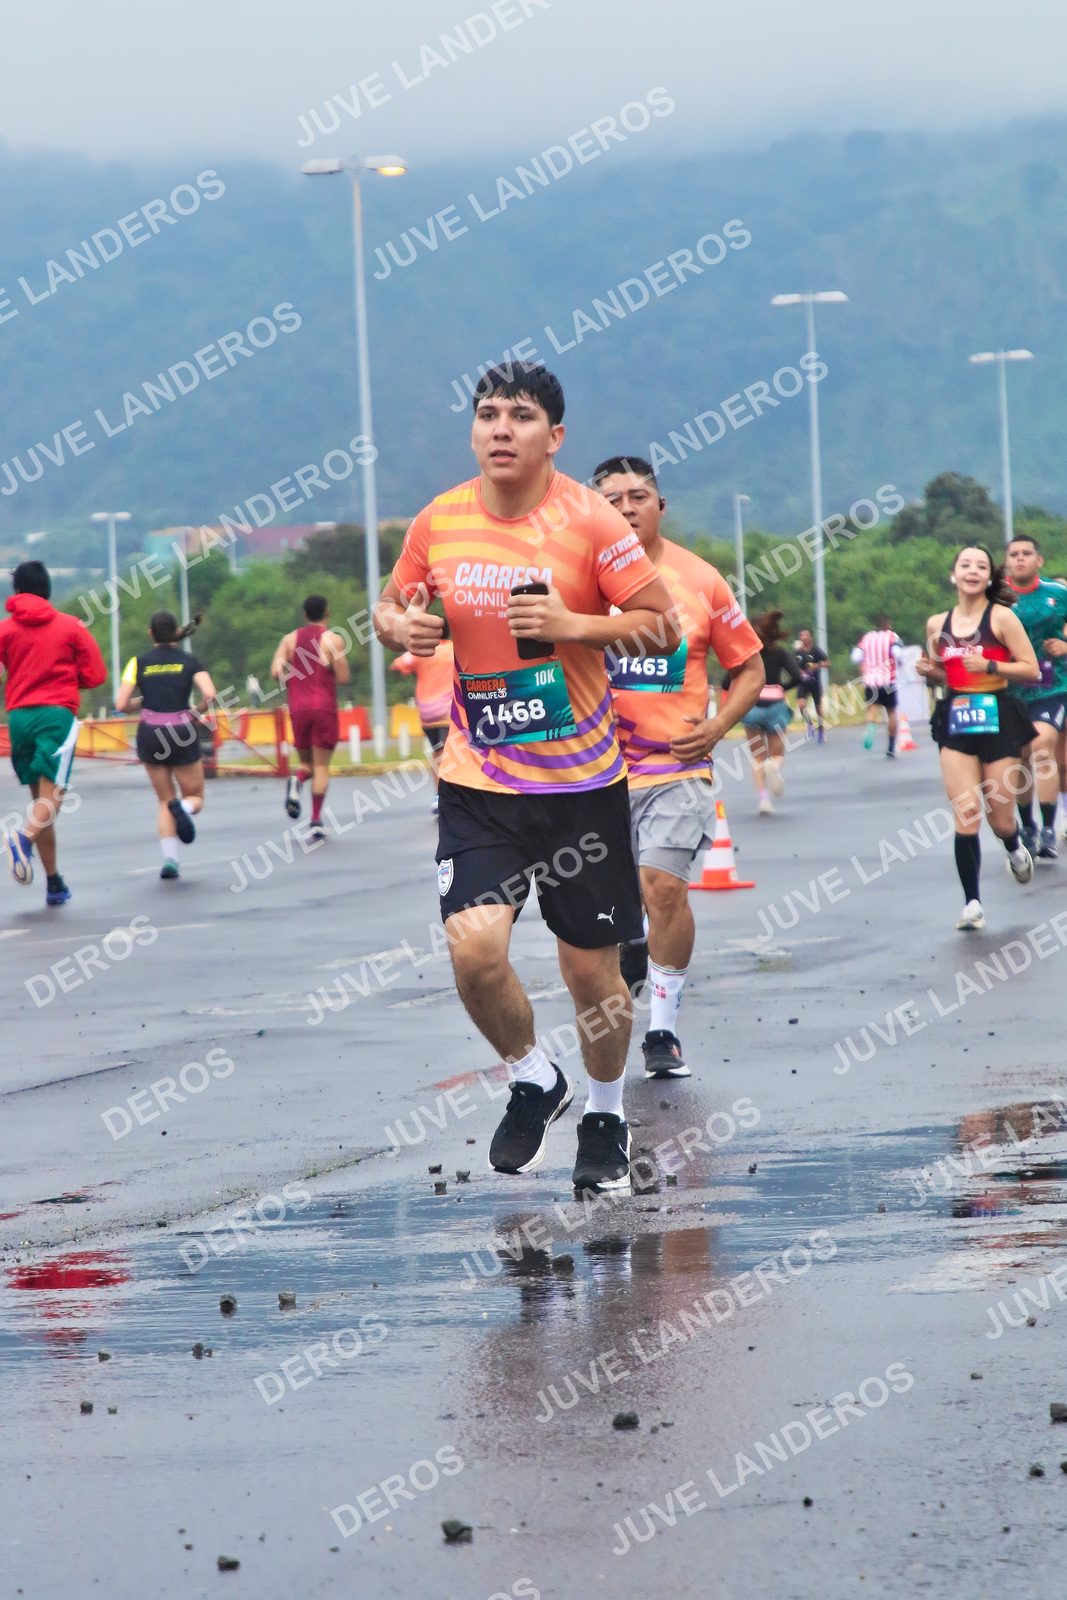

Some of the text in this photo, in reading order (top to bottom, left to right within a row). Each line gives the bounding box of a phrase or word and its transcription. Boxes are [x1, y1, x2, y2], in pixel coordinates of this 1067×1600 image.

[454, 590, 518, 607] OMNIL
[619, 657, 668, 676] 1463
[466, 678, 506, 691] CARRERA
[534, 668, 556, 686] 10K
[482, 699, 546, 725] 1468
[956, 709, 987, 723] 1413
